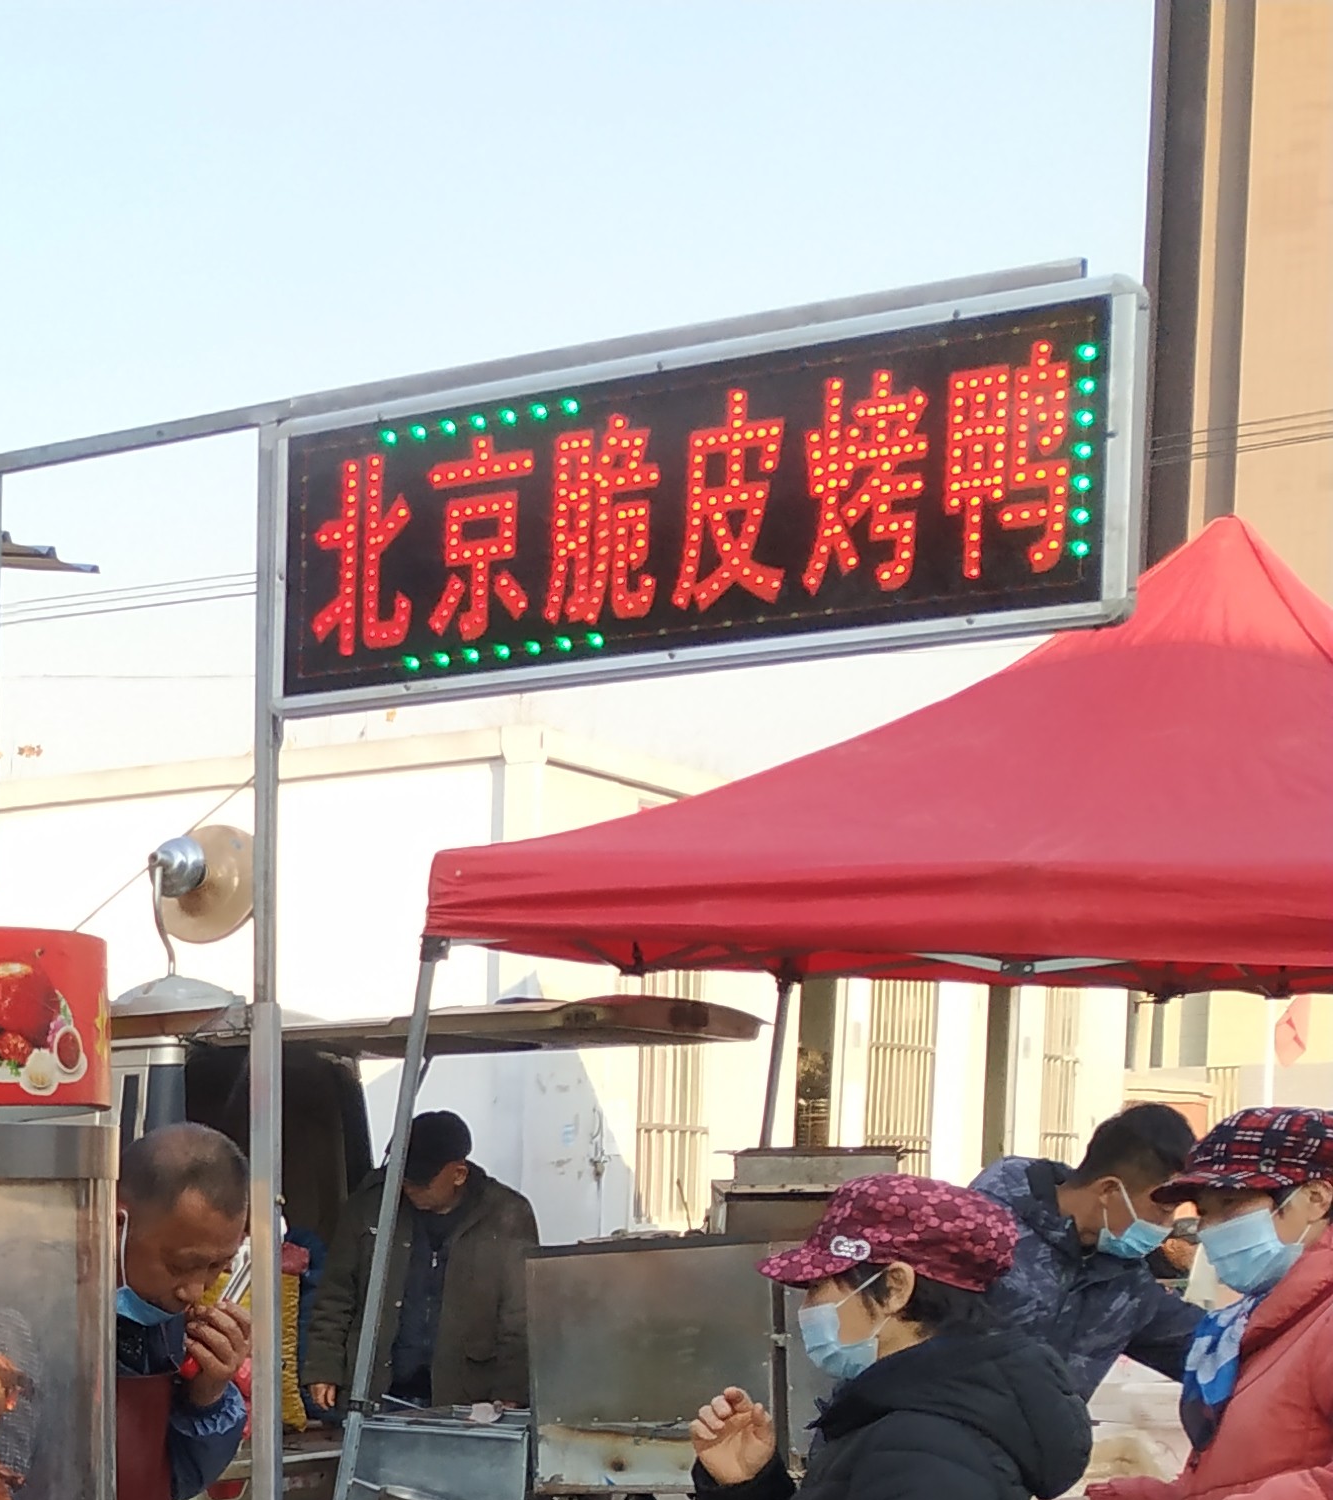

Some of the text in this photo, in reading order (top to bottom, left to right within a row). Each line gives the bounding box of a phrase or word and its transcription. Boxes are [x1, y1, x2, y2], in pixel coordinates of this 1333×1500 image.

[312, 340, 1071, 657] 北京脆皮烤鸭
